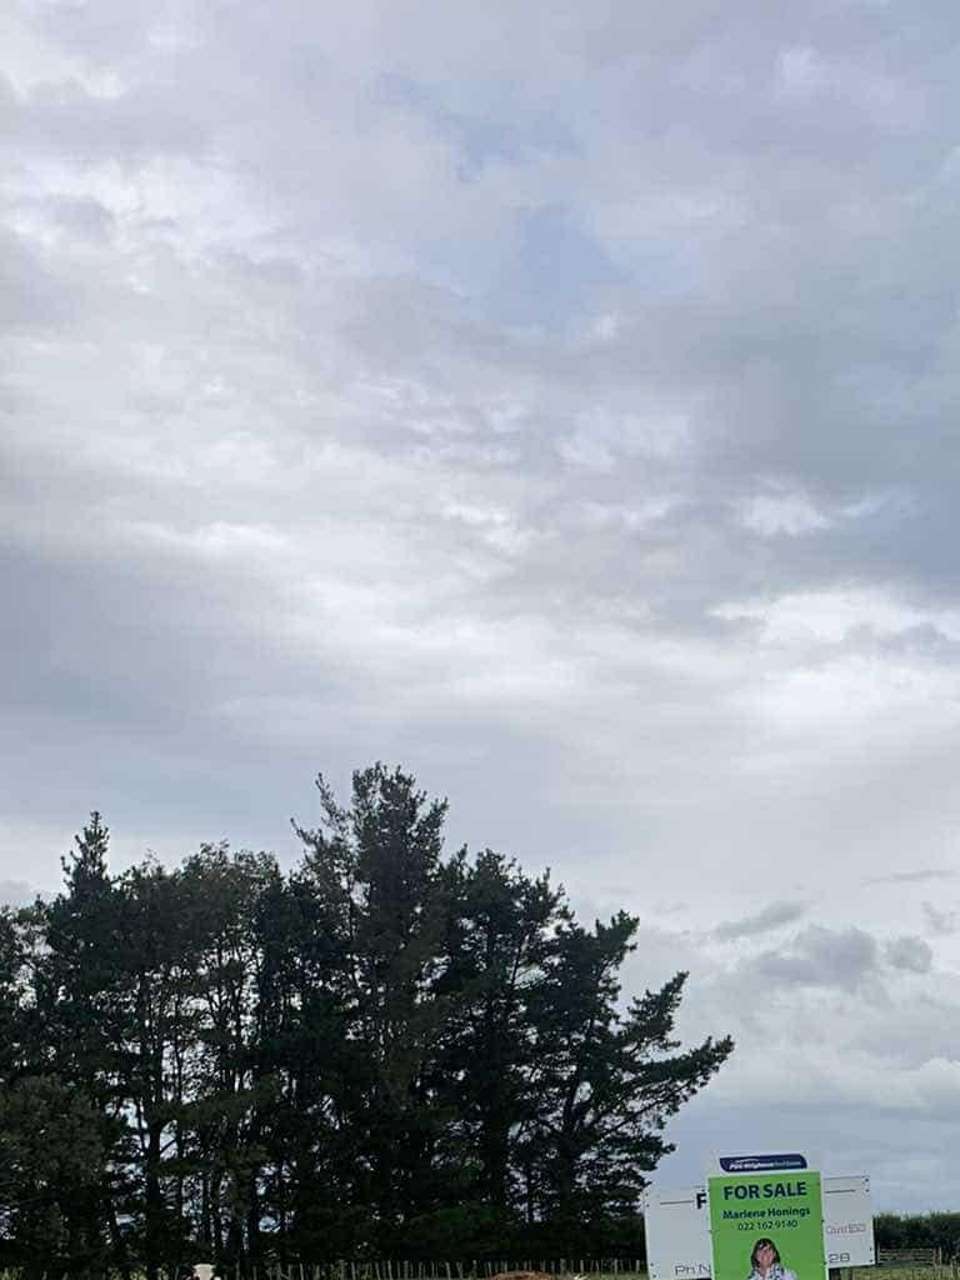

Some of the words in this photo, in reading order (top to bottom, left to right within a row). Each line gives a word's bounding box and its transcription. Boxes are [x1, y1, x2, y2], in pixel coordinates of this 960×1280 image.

[723, 1184, 761, 1201] FOR
[763, 1180, 808, 1199] SALE
[722, 1208, 767, 1220] Marlene
[767, 1206, 811, 1218] Honings
[737, 1221, 754, 1232] 022
